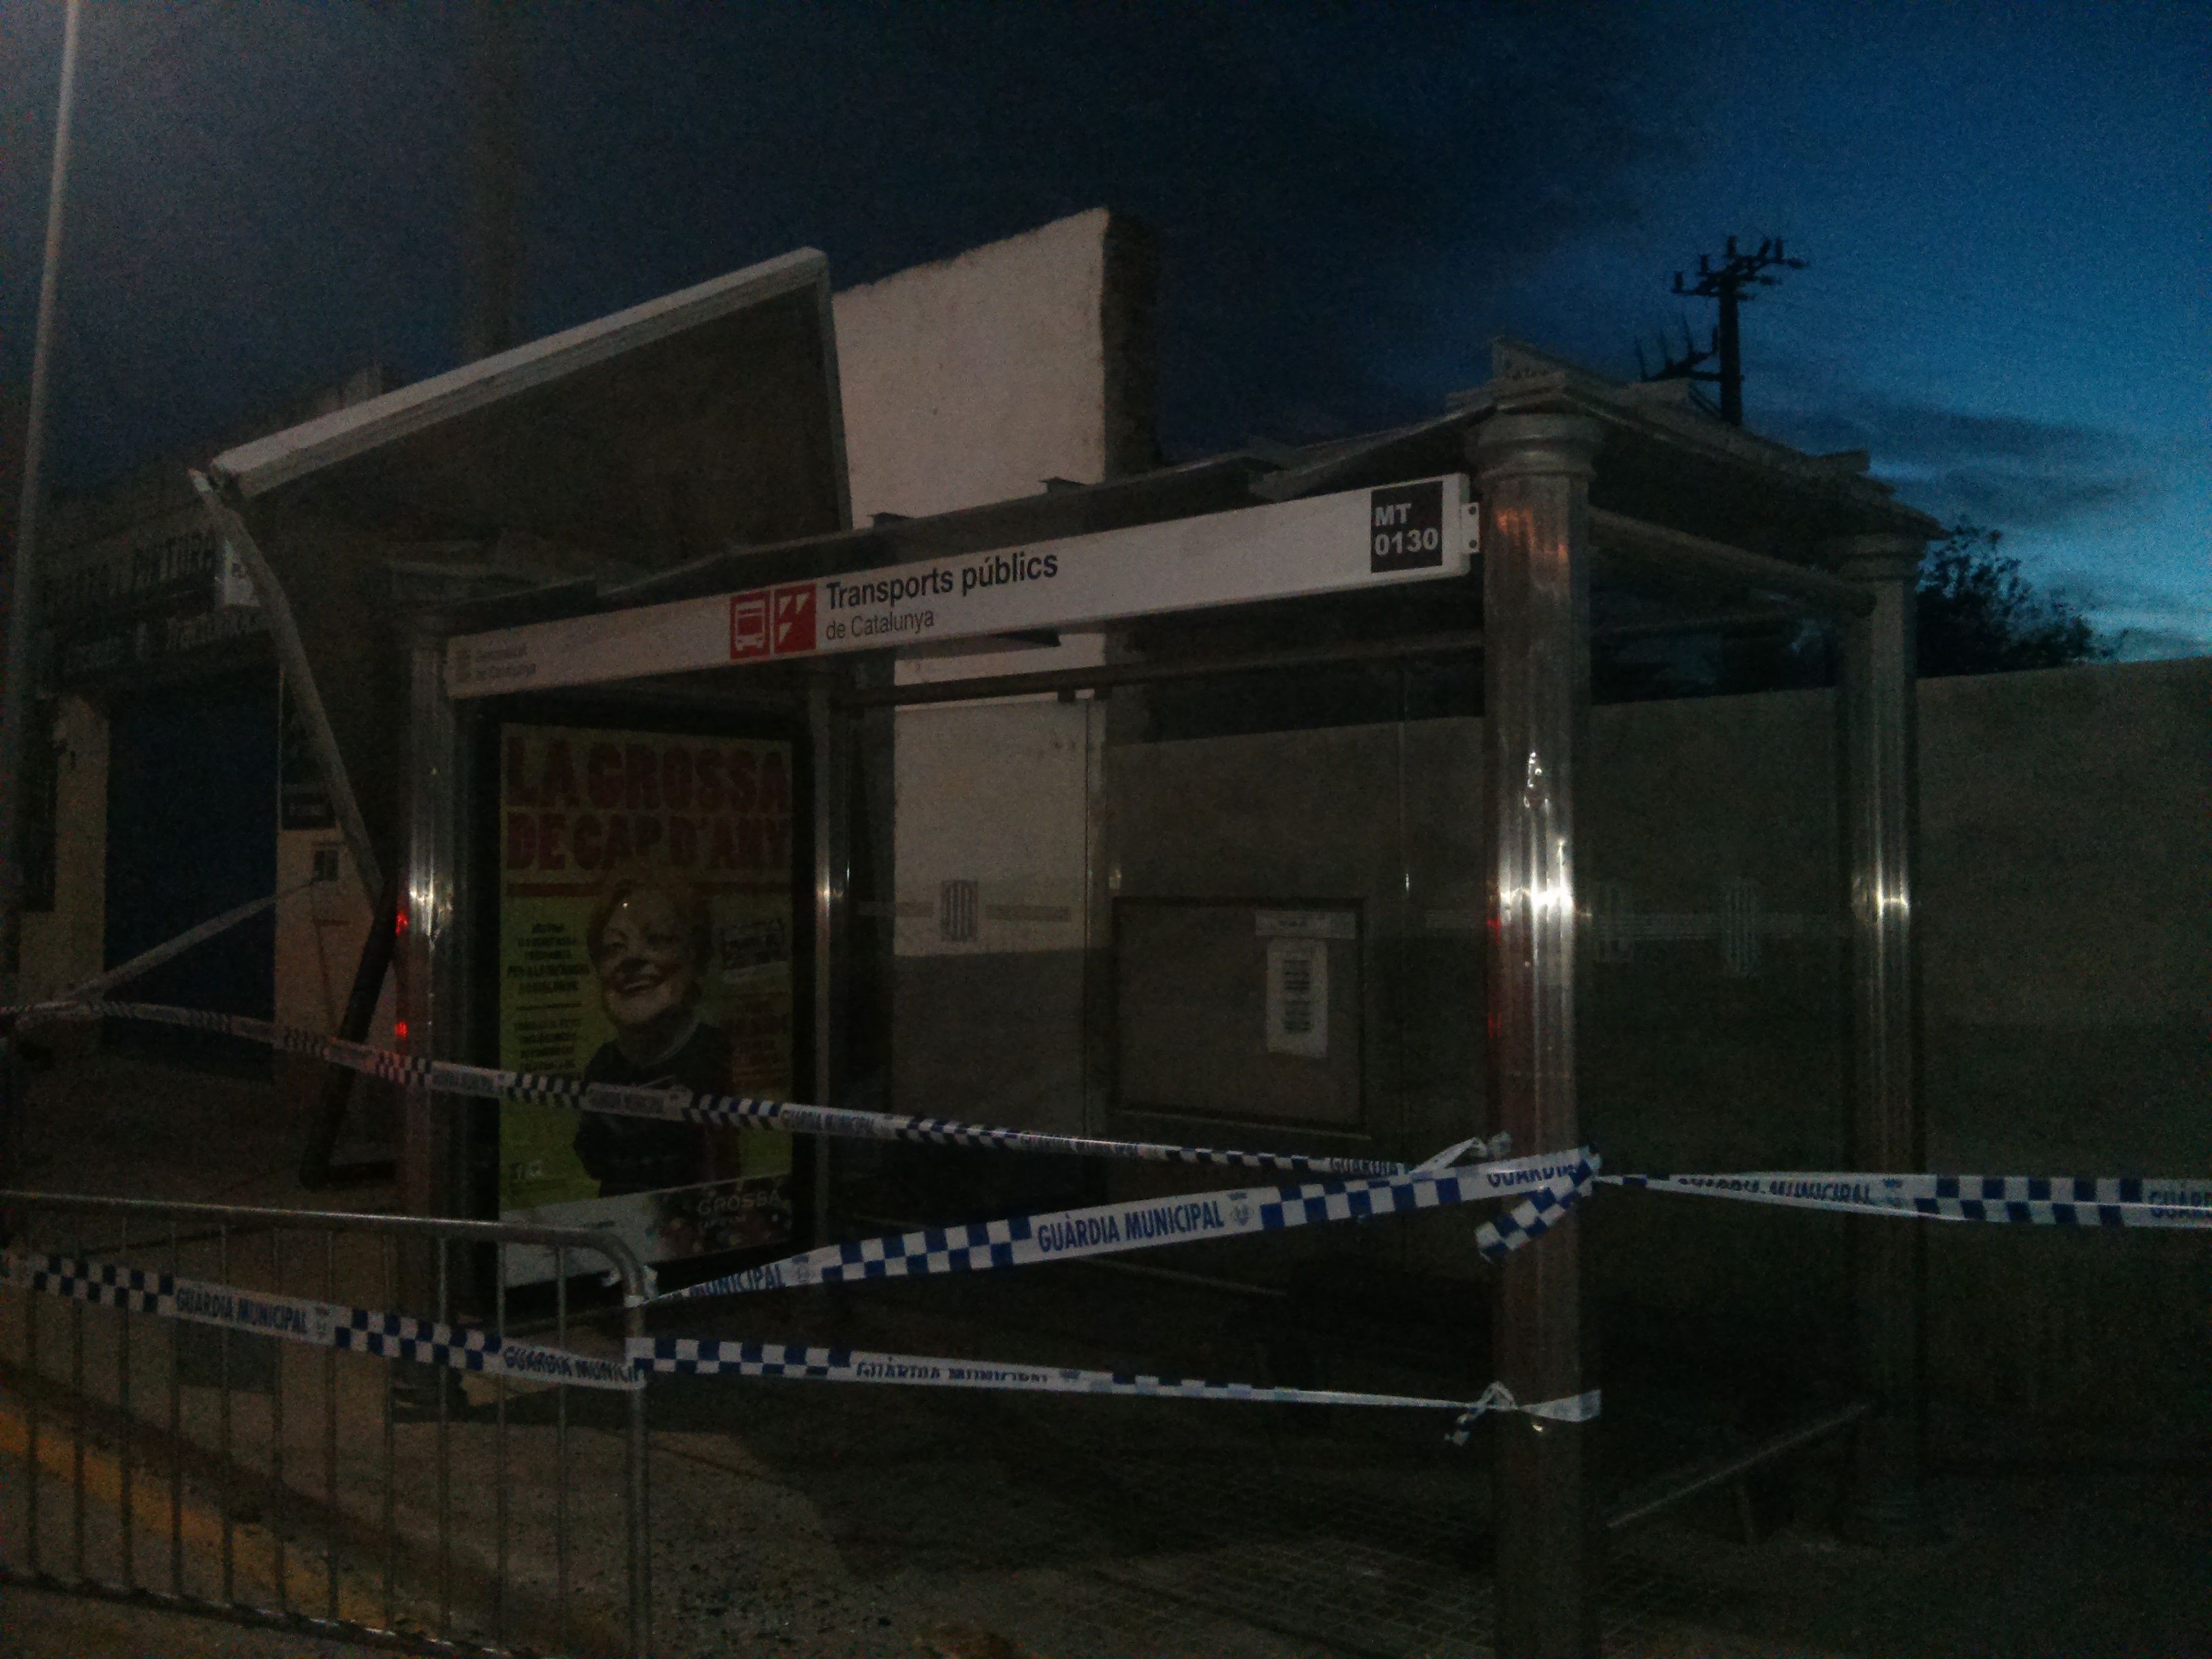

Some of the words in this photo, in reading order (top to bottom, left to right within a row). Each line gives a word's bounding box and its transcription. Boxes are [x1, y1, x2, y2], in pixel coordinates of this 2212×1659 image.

[1374, 502, 1412, 527] MT
[1374, 527, 1439, 556] 0130
[826, 567, 954, 610] Transports
[962, 552, 1059, 596] públics
[826, 619, 846, 640] de
[851, 609, 935, 636] Catalunya
[506, 735, 581, 808] LA
[587, 743, 789, 813] GROSSA
[506, 813, 566, 871] DE
[573, 813, 663, 872] CAP
[1038, 1214, 1121, 1252] GUÀRDIA
[1125, 1201, 1224, 1242] MUNICIPAL
